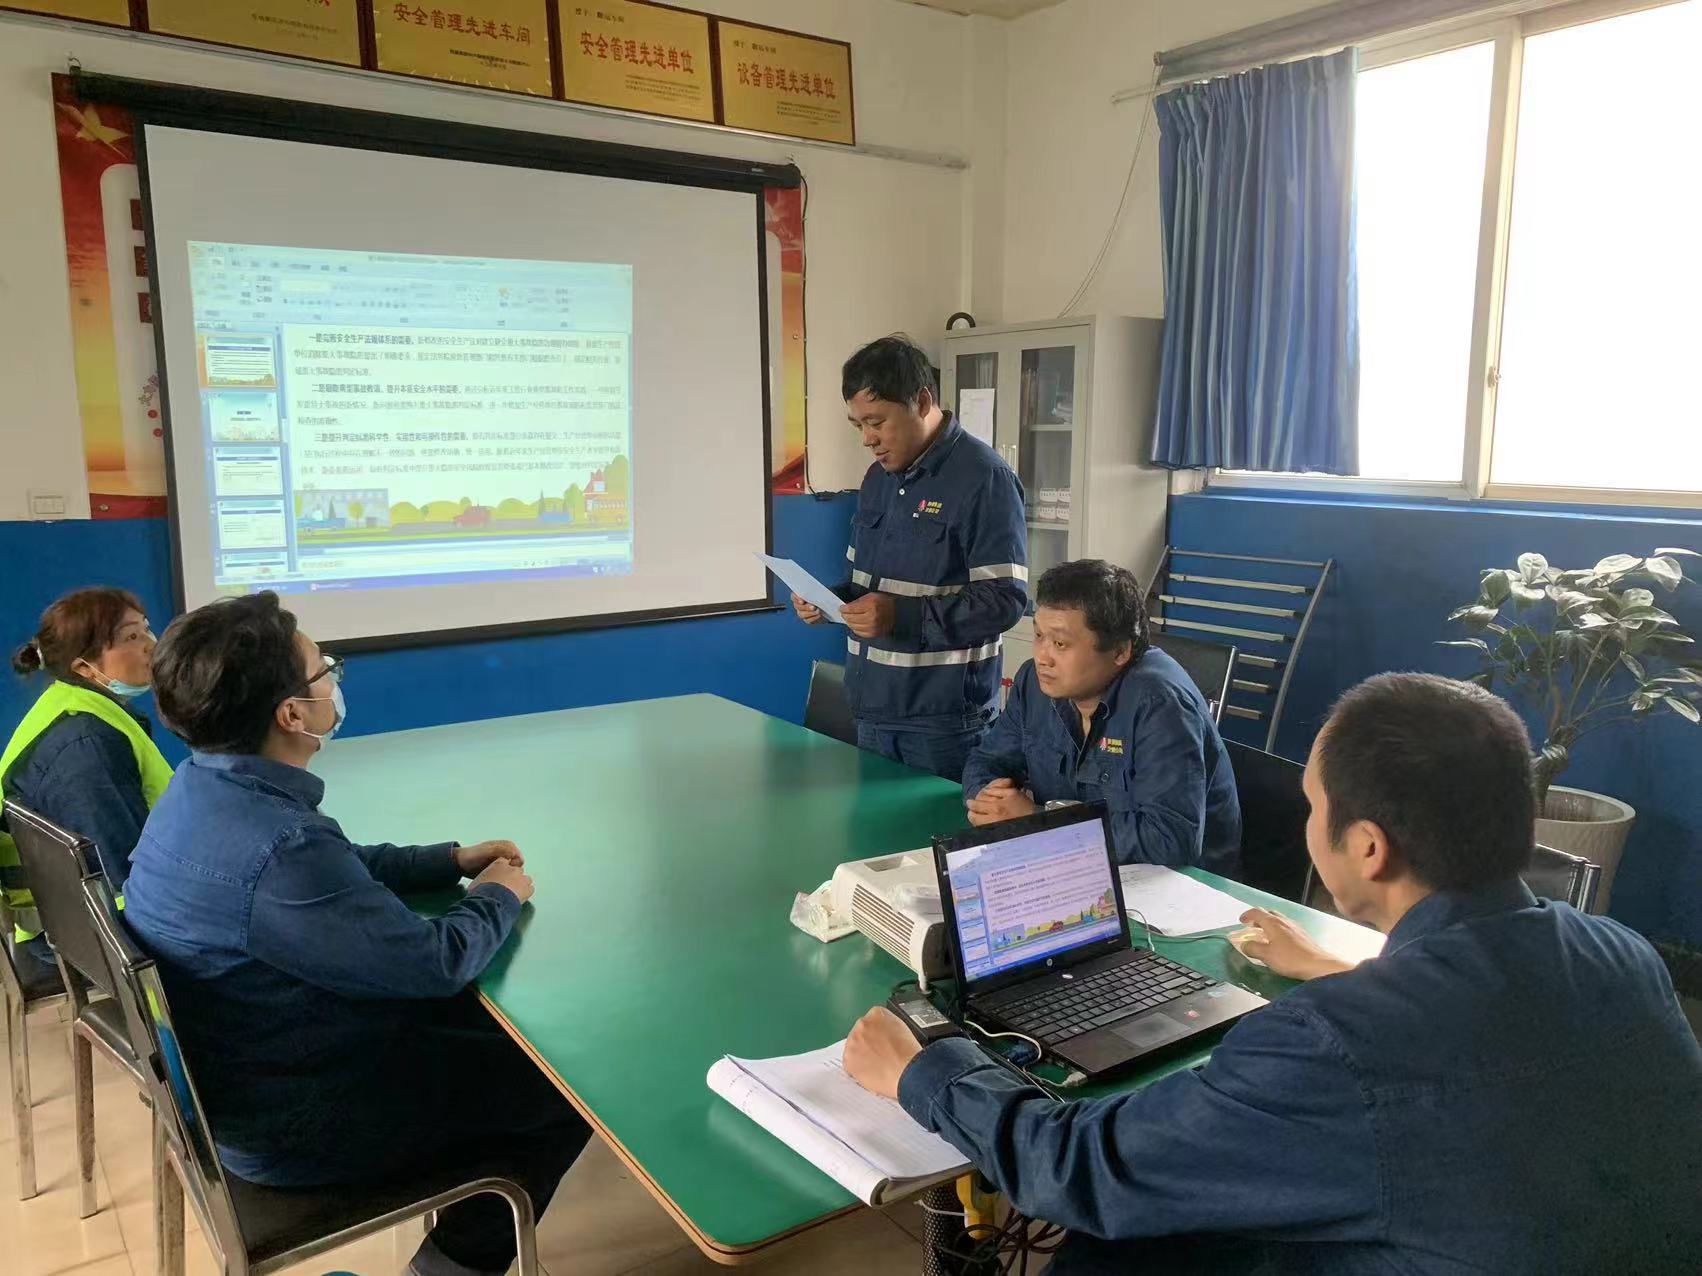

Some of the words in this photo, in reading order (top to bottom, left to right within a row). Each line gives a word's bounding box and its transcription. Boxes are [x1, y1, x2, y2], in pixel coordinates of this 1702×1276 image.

[393, 2, 532, 47] 安全管理先进车间
[579, 30, 695, 75] 安全管理先进单位
[737, 62, 837, 101] 设备管理先进单位
